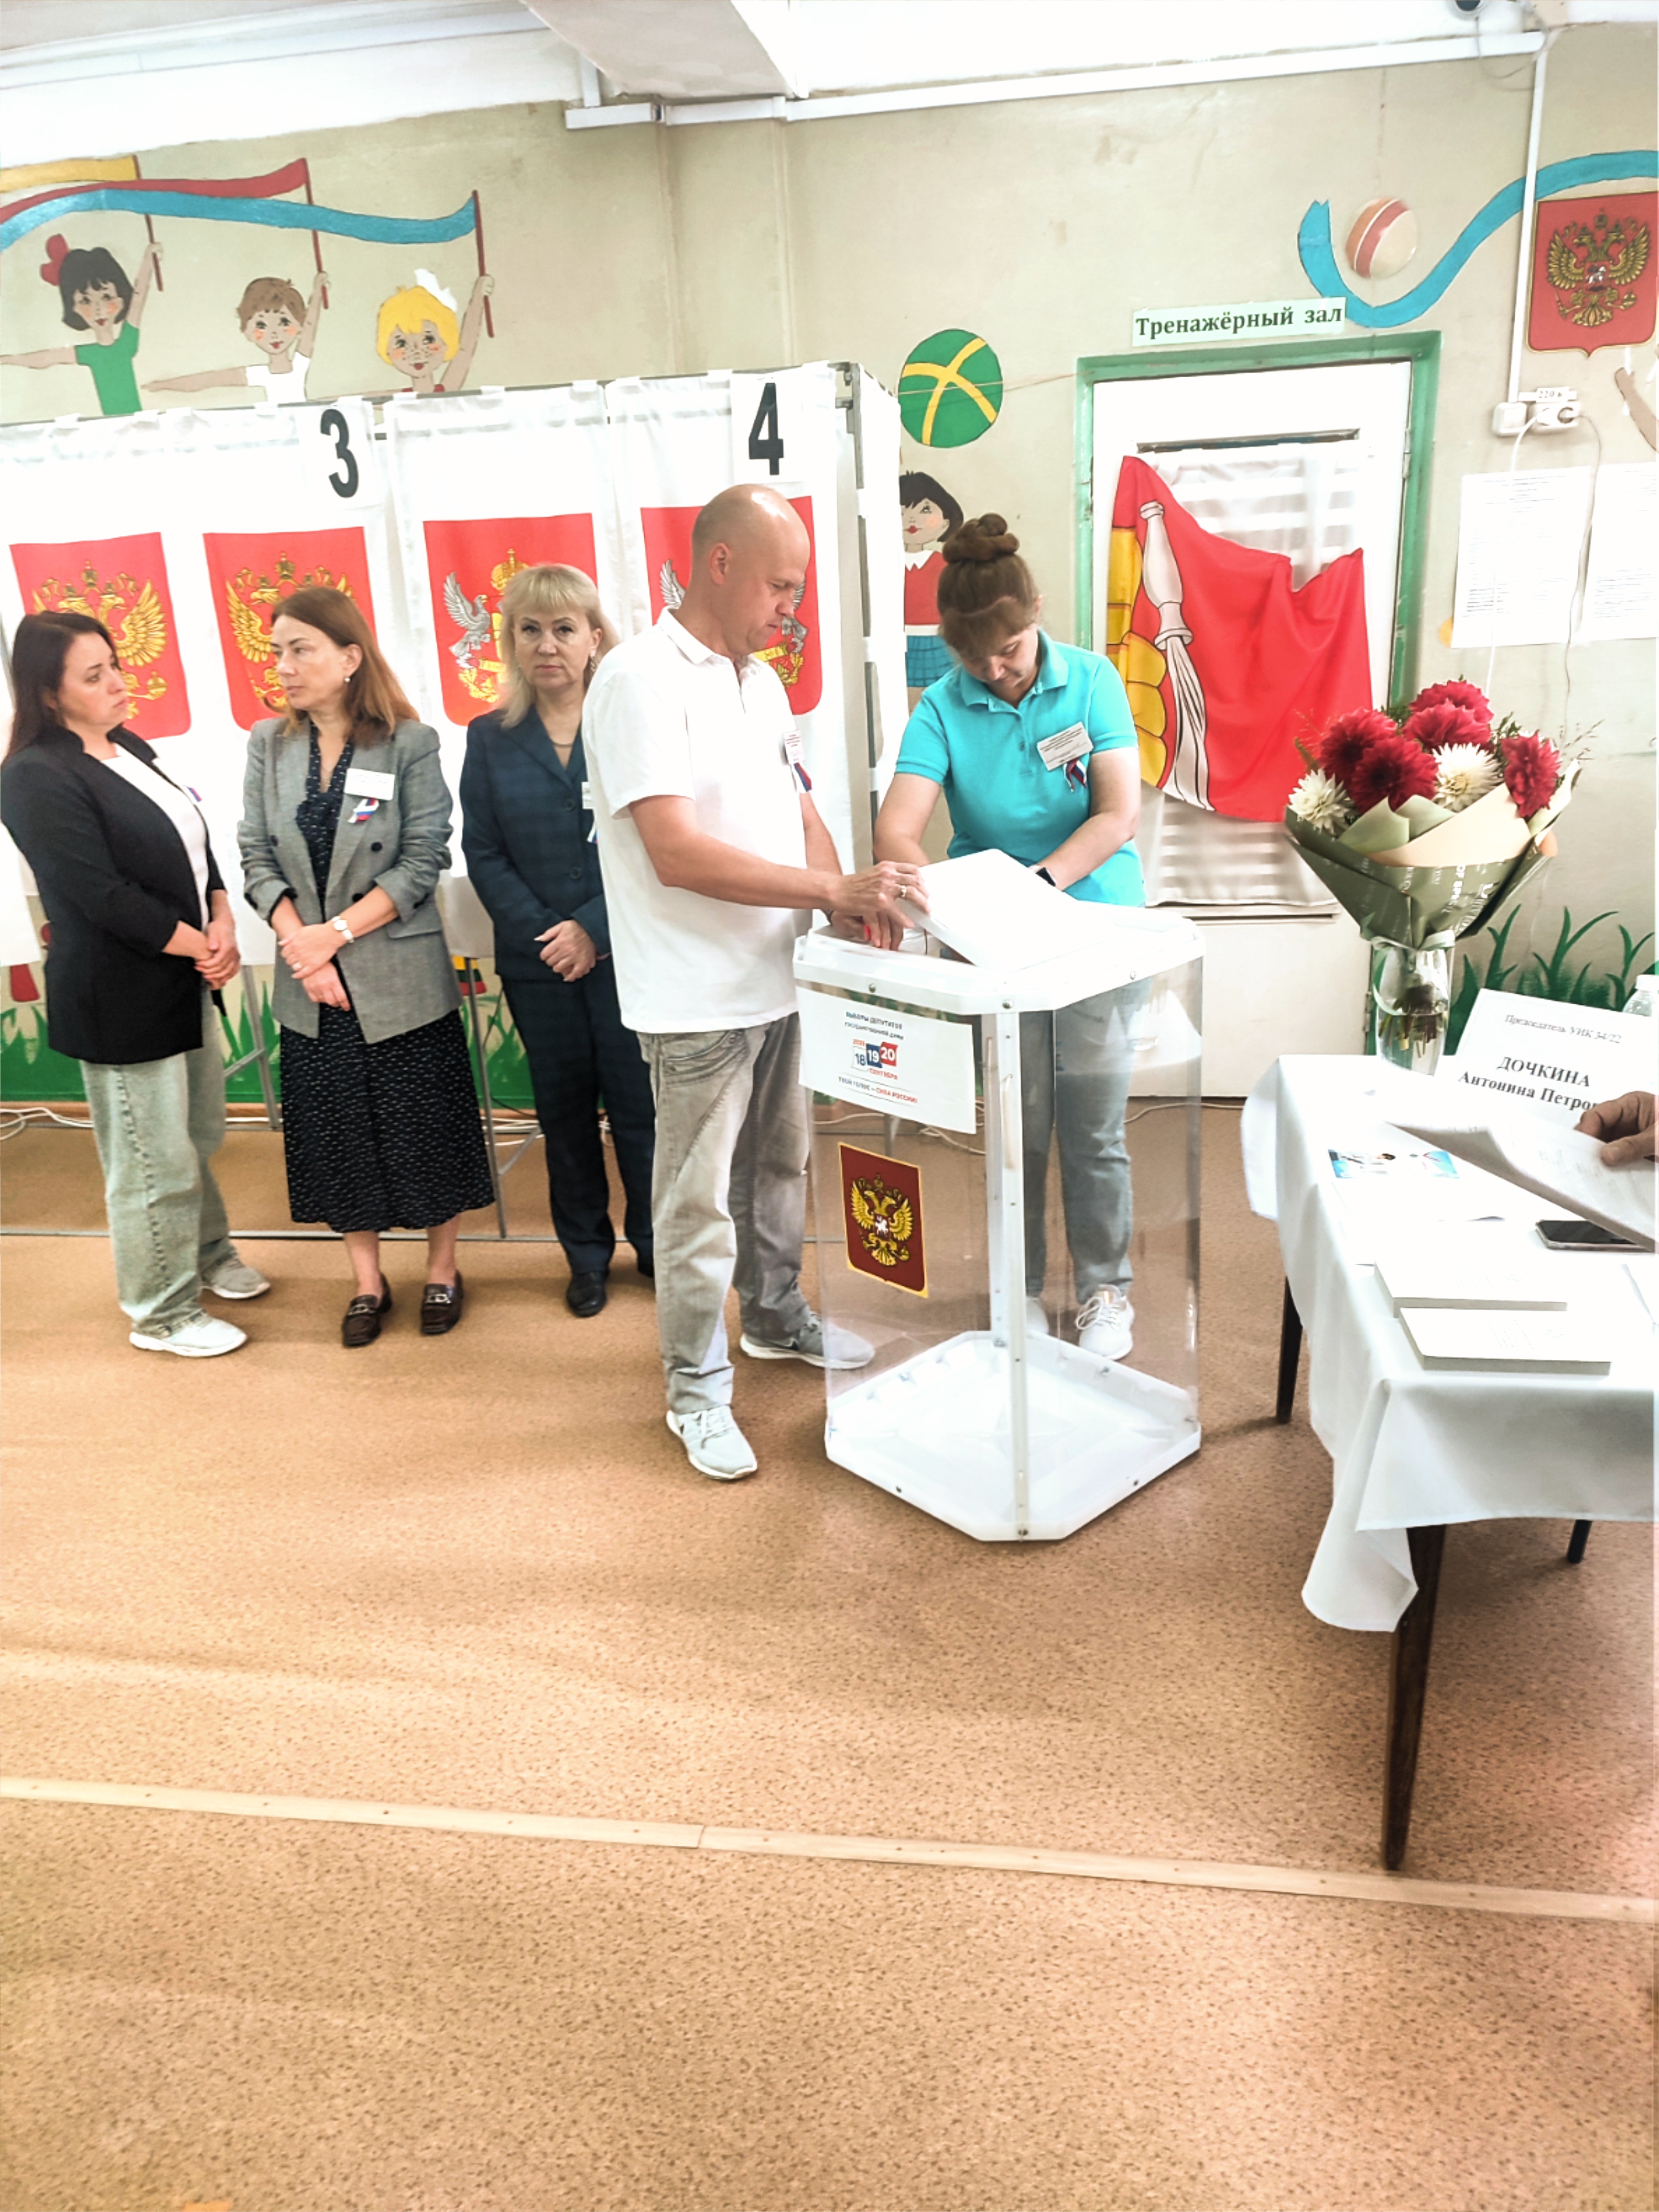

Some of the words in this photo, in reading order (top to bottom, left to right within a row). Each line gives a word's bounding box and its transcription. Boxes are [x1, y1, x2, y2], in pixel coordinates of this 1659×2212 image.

[1135, 307, 1293, 339] Тренажёрный
[1305, 307, 1342, 324] зал
[749, 383, 784, 476] 4
[320, 409, 359, 498] 3
[1504, 1014, 1566, 1032] Председатель
[1569, 1026, 1593, 1038] УИК
[855, 1053, 866, 1066] 18
[868, 1050, 879, 1063] 19
[880, 1047, 895, 1061] 20
[1458, 1071, 1536, 1099] Антонина
[1497, 1057, 1590, 1087] ДОЧКИНА
